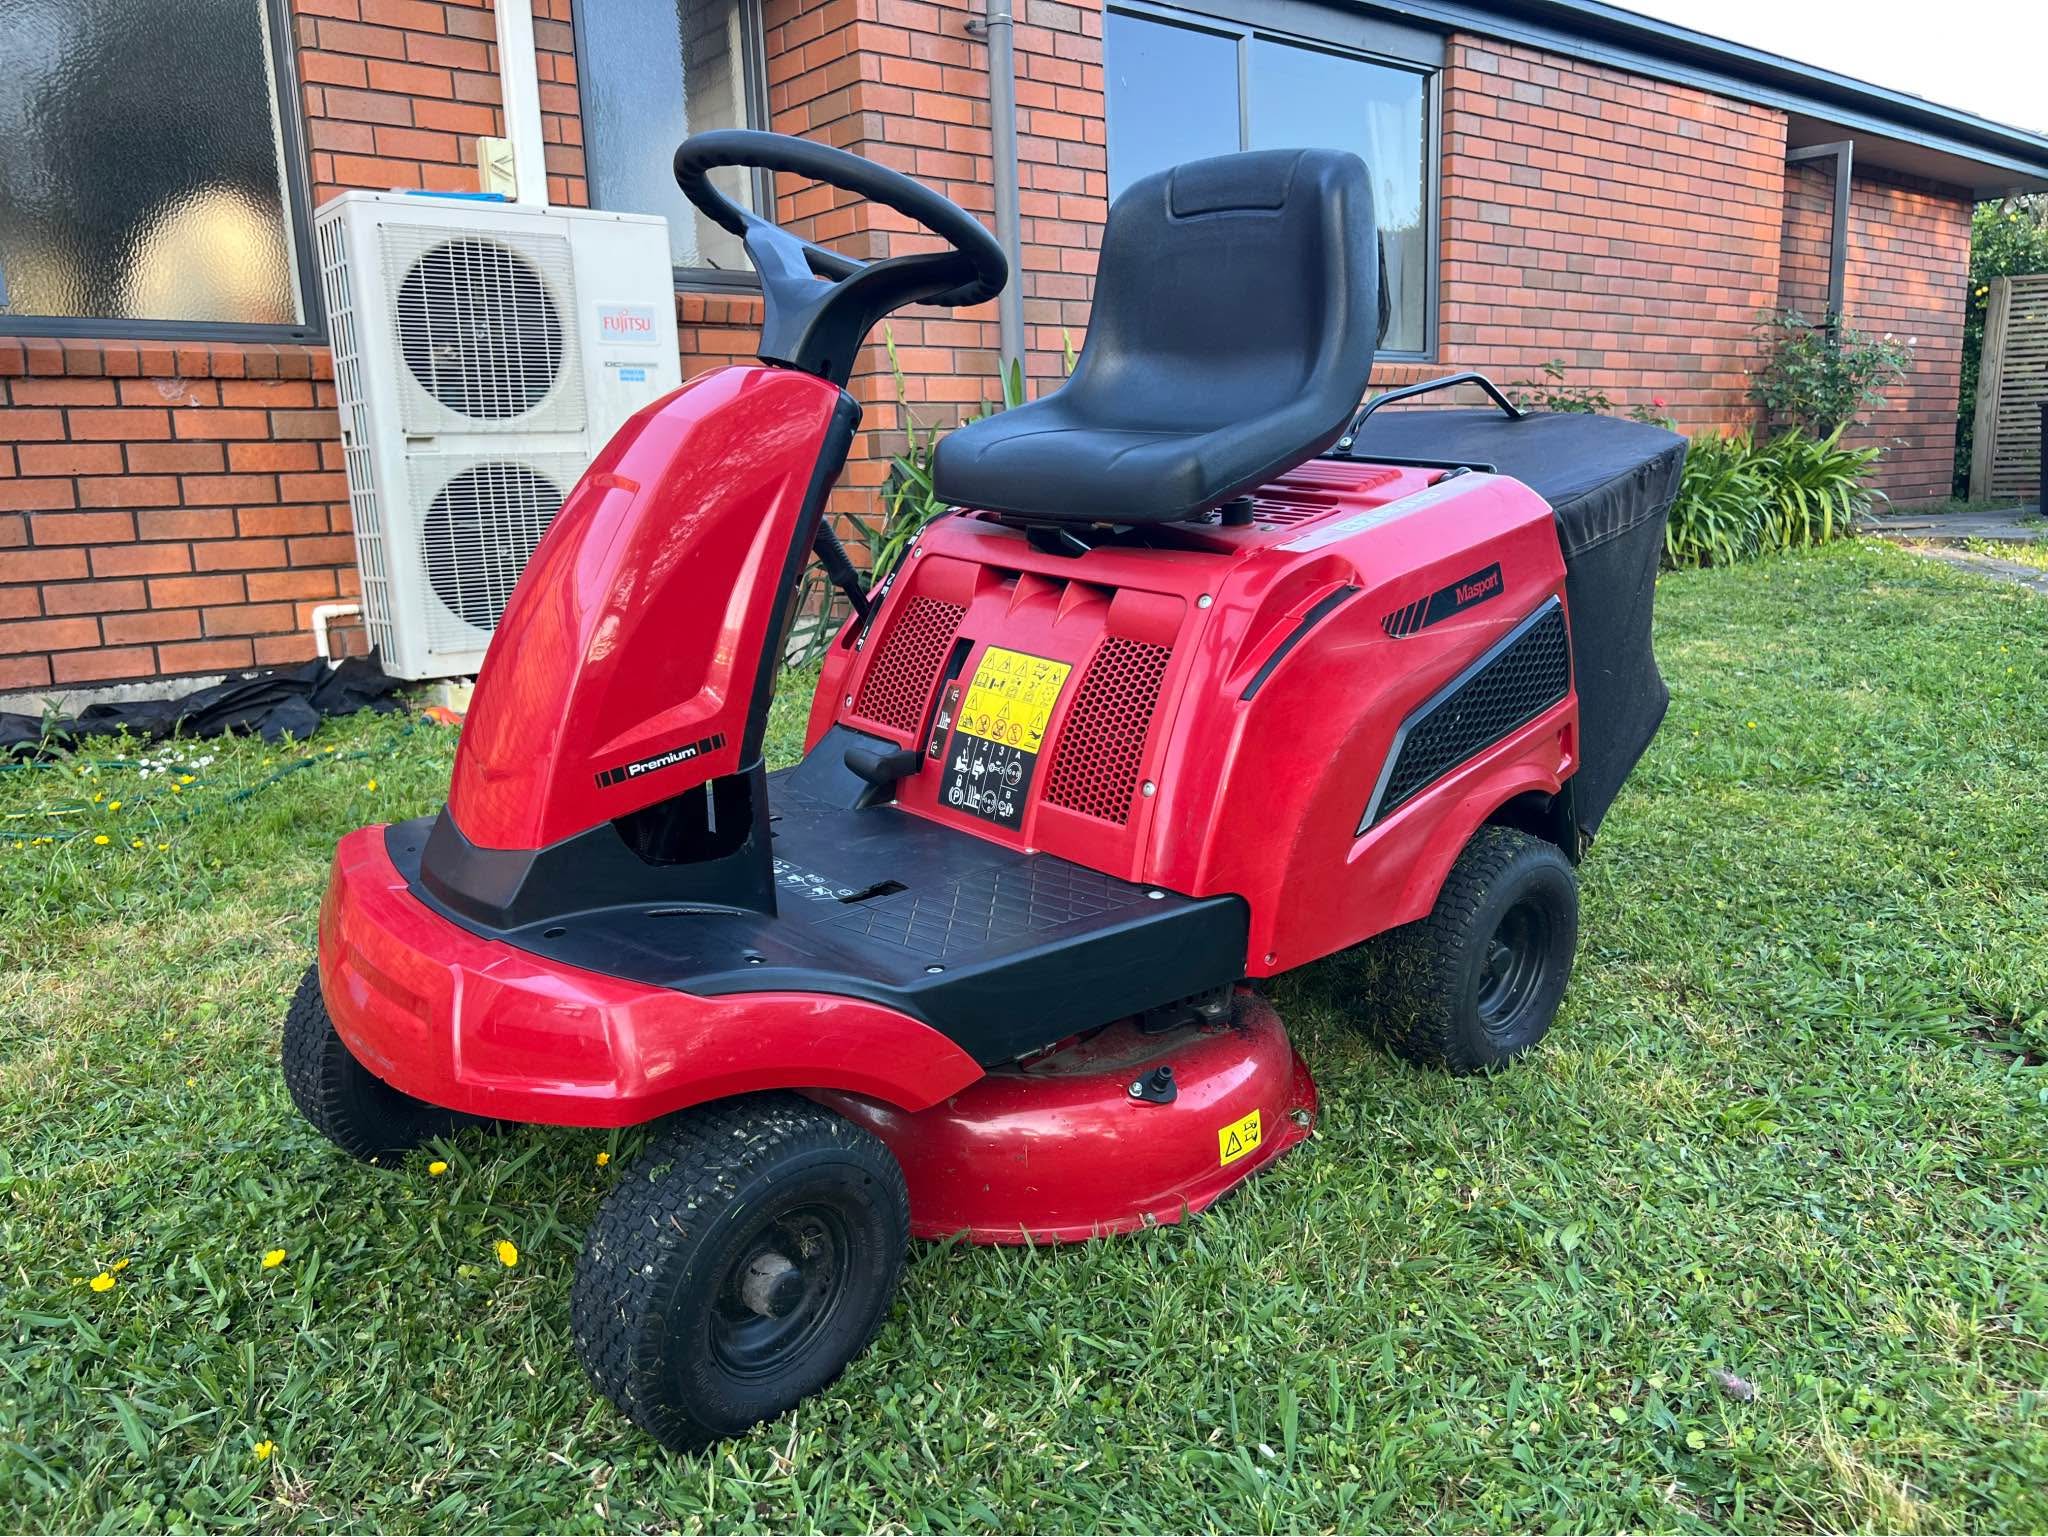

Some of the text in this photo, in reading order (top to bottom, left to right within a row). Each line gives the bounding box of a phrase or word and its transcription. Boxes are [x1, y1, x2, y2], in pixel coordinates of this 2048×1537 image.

[603, 309, 651, 334] FUJITSU
[1455, 572, 1498, 605] Masport
[967, 736, 1021, 760] 1 2 3 A
[629, 748, 696, 776] Premium
[1005, 790, 1012, 799] B
